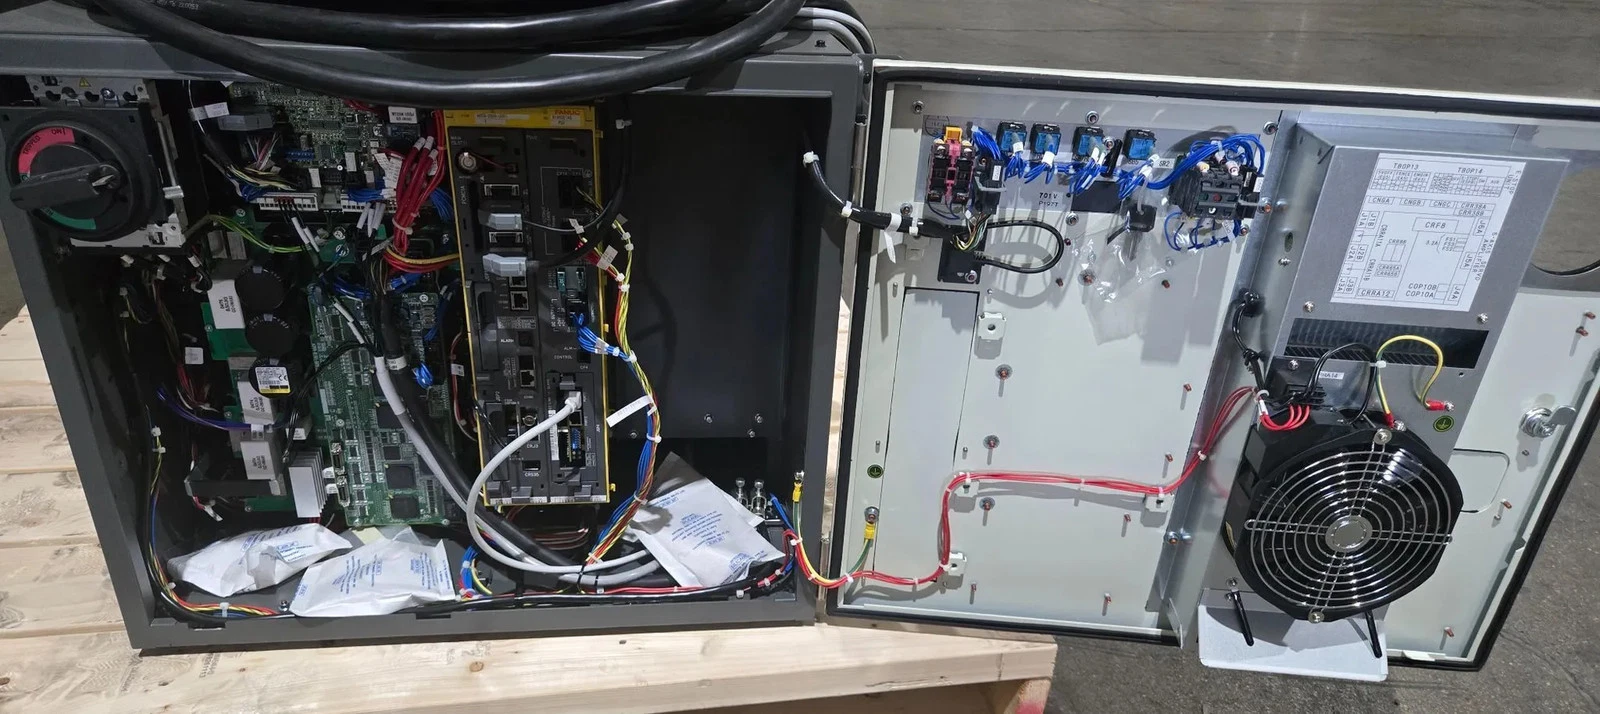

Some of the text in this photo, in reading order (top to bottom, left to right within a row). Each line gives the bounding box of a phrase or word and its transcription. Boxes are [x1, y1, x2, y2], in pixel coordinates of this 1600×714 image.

[1476, 220, 1485, 233] J6A
[1464, 254, 1472, 267] J5A
[1472, 239, 1488, 272] AMPLIFIER
[1475, 261, 1486, 280] SERVO
[1452, 286, 1461, 299] J4A
